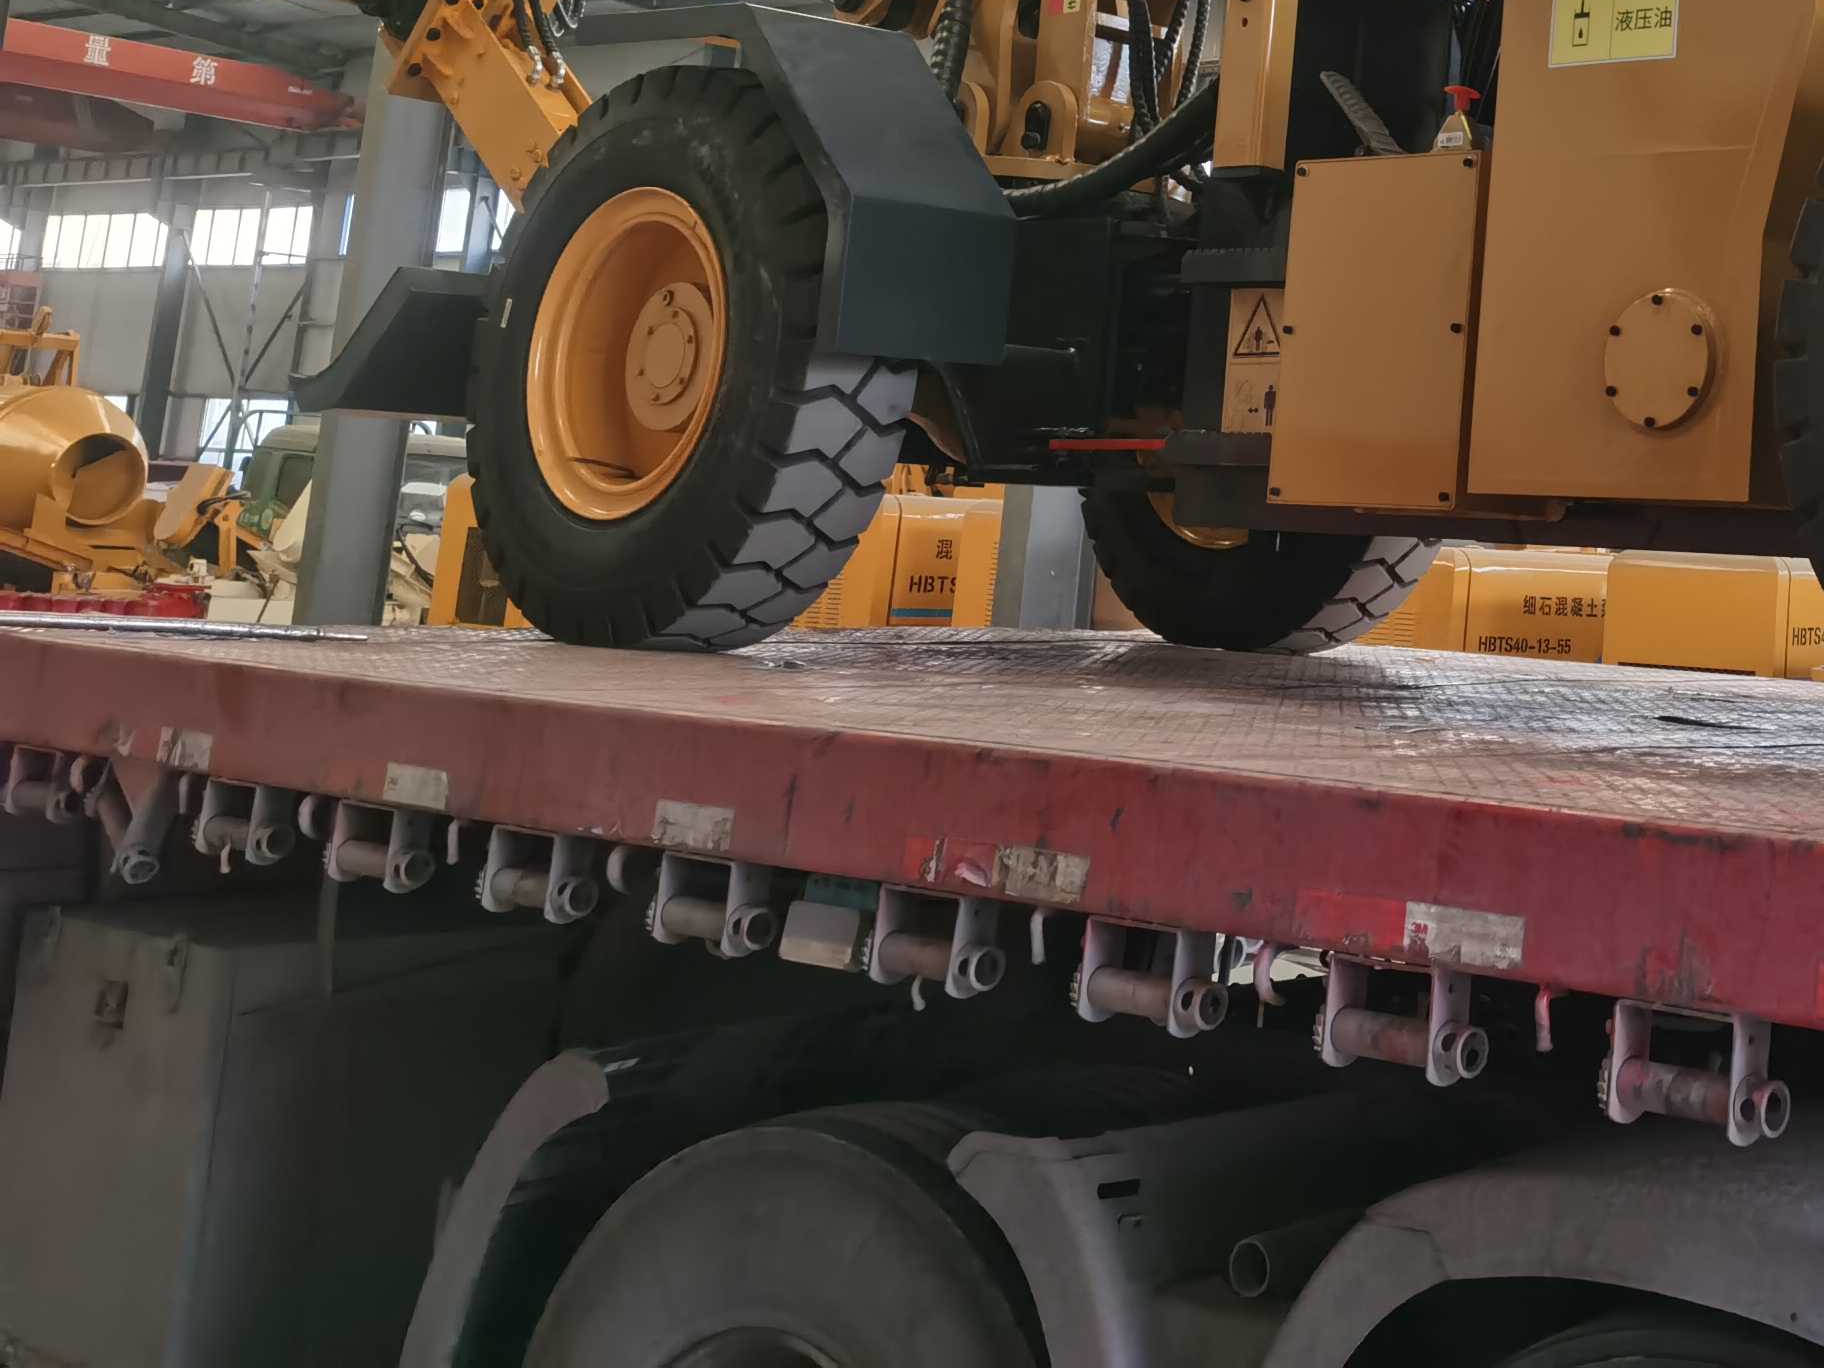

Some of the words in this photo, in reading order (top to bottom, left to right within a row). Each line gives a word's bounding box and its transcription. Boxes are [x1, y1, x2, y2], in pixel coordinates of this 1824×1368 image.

[1615, 6, 1672, 32] 液压油
[935, 539, 953, 560] 混
[1478, 636, 1571, 654] HBTS40-13-55
